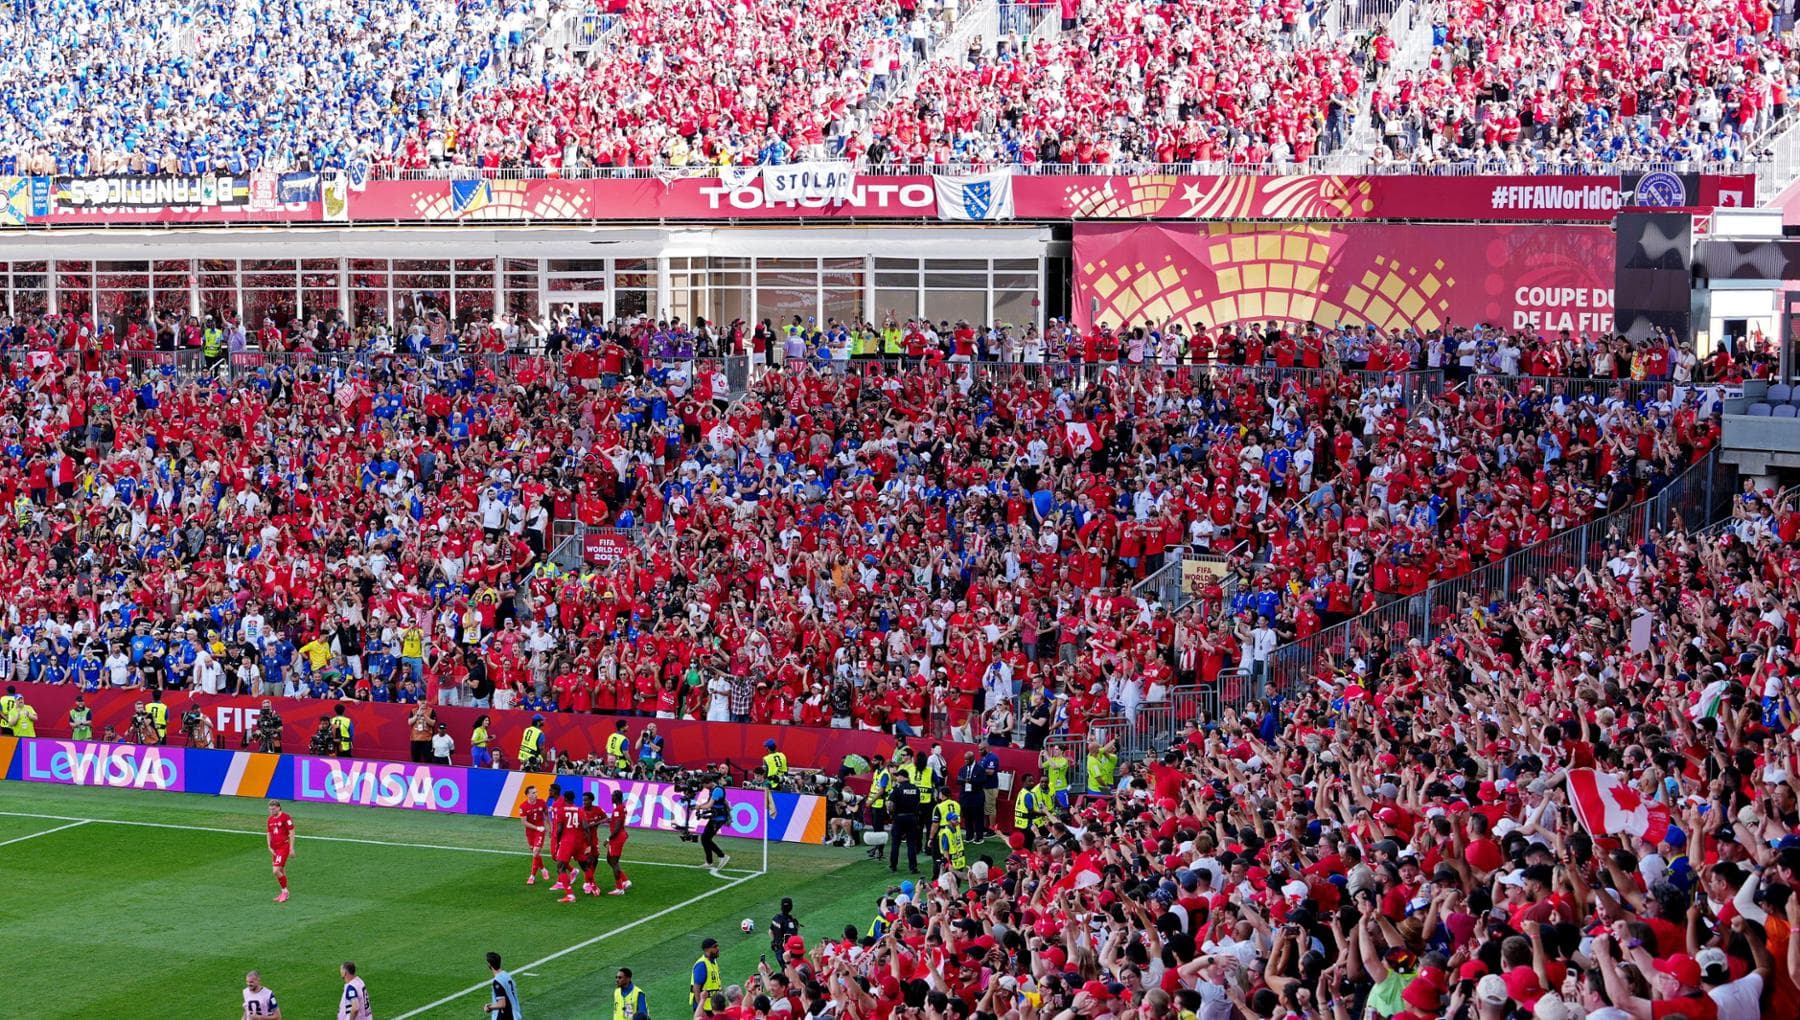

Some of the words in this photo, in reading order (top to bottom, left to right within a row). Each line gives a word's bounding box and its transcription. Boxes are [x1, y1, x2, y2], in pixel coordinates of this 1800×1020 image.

[71, 177, 202, 205] FANATICS
[776, 171, 847, 191] STOLAC
[699, 183, 934, 209] TONTO
[1491, 185, 1621, 210] #FIFAWorldCu
[1515, 286, 1588, 307] COUPE
[1513, 311, 1542, 331] DE
[1545, 311, 1574, 332] LA
[1579, 312, 1616, 333] FIF
[217, 706, 261, 733] FIF
[29, 741, 178, 787] Lenovo
[56, 740, 167, 790] VISA
[302, 759, 460, 808] Lenovo
[319, 758, 437, 810] VISA
[565, 811, 579, 829] 24
